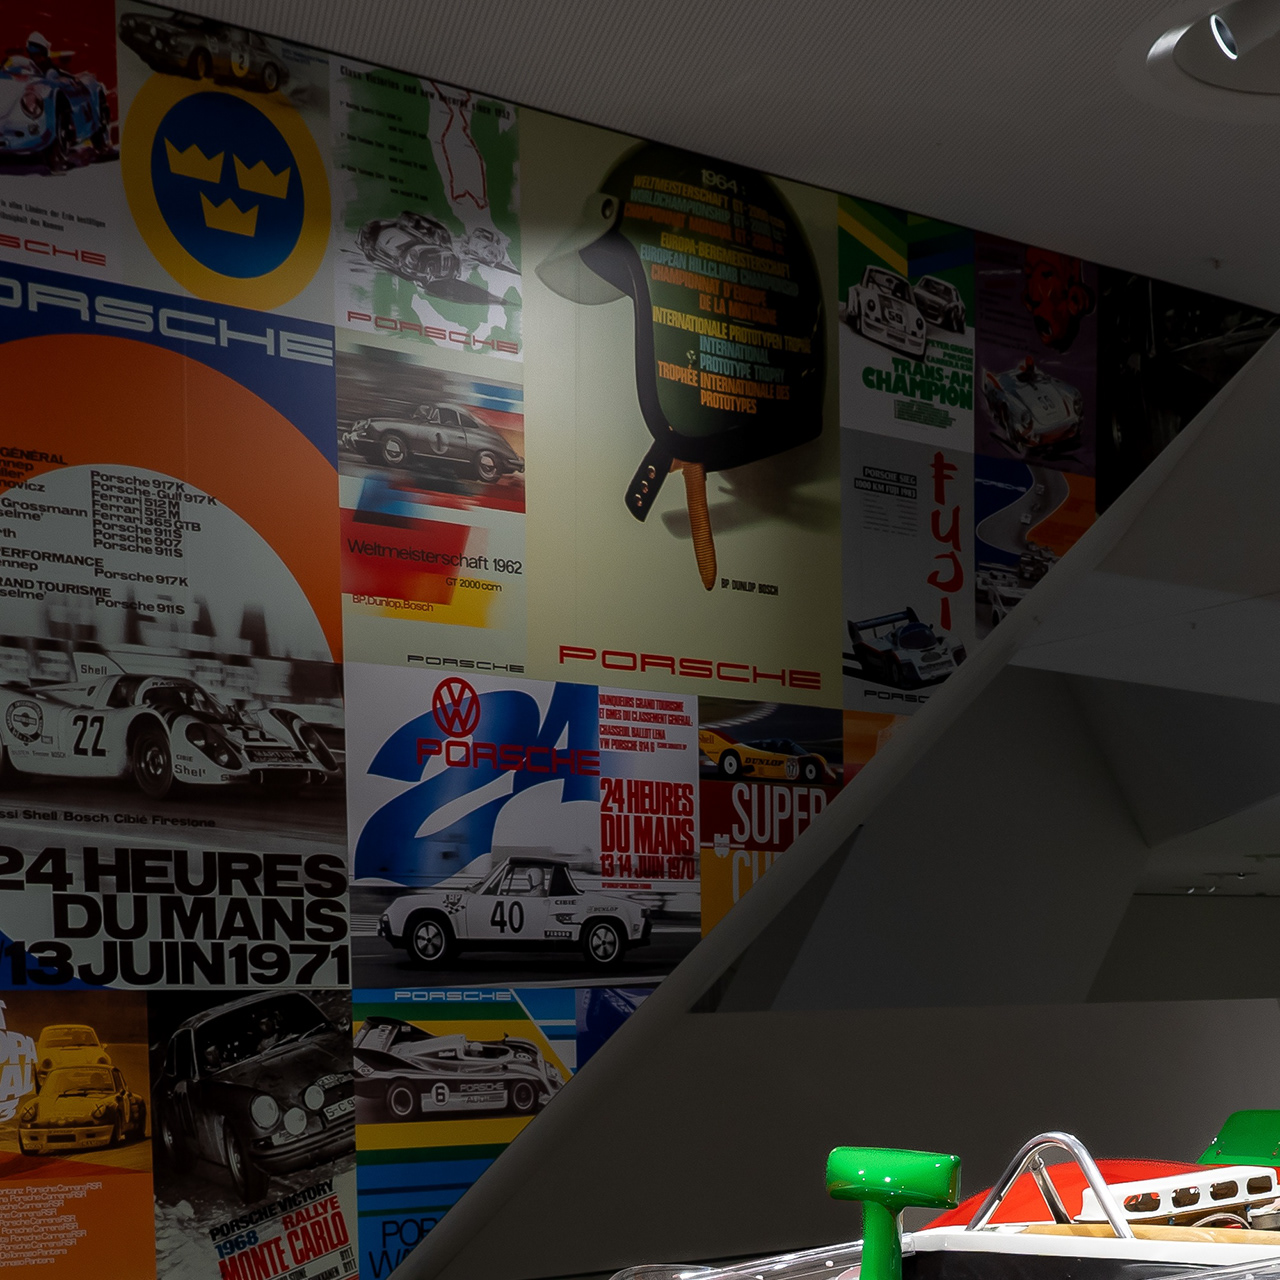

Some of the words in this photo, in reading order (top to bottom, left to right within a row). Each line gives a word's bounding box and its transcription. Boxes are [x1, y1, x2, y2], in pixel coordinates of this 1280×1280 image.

[640, 244, 687, 267] EUROPEAN
[347, 309, 519, 356] PORSCHE
[652, 305, 727, 339] INTERNATIONALE
[861, 366, 973, 411] CHAMPION
[891, 357, 973, 389] TRANS-AM
[700, 389, 757, 414] PROTOTYPES
[865, 468, 898, 482] PORSCHE
[899, 474, 916, 486] SIEG
[872, 482, 885, 493] KM
[92, 510, 143, 525] Ferrari
[347, 538, 489, 571] Weltmeisterschaft
[493, 558, 523, 575] 1962
[36, 580, 111, 597] TOURISME
[445, 577, 458, 587] GT
[459, 578, 481, 590] 2000
[481, 582, 503, 592] ccm
[722, 578, 729, 589] BP
[732, 580, 756, 592] DUNLOP
[758, 584, 778, 595] BOSCH
[80, 663, 108, 676] Shell
[407, 654, 525, 674] PORSCHE
[559, 645, 821, 690] PORSCHE
[72, 714, 108, 757] 22
[415, 737, 600, 777] PORSCHE
[600, 778, 625, 814] 24
[626, 779, 694, 816] HEURES
[23, 809, 58, 822] Shell
[63, 811, 109, 824] Bosch
[151, 815, 216, 828] Firestone
[601, 814, 630, 853] DU
[634, 815, 694, 856] MANS
[83, 848, 347, 898] HEURES
[600, 855, 615, 877] 13
[617, 856, 632, 878] 14
[634, 856, 665, 879] JUIN
[667, 857, 695, 880] 1970
[52, 893, 148, 940] DU
[160, 897, 348, 943] MANS
[490, 900, 524, 933] 40
[78, 940, 226, 985] JUIN
[227, 943, 349, 986] 1971
[394, 991, 512, 1001] PORSCHE
[435, 1086, 446, 1102] 6
[209, 1201, 277, 1242] PORSCHE
[278, 1179, 334, 1213] VICTORY
[282, 1195, 340, 1231] RALLYE
[214, 1229, 259, 1258] 1968
[286, 1211, 349, 1266] CARLO
